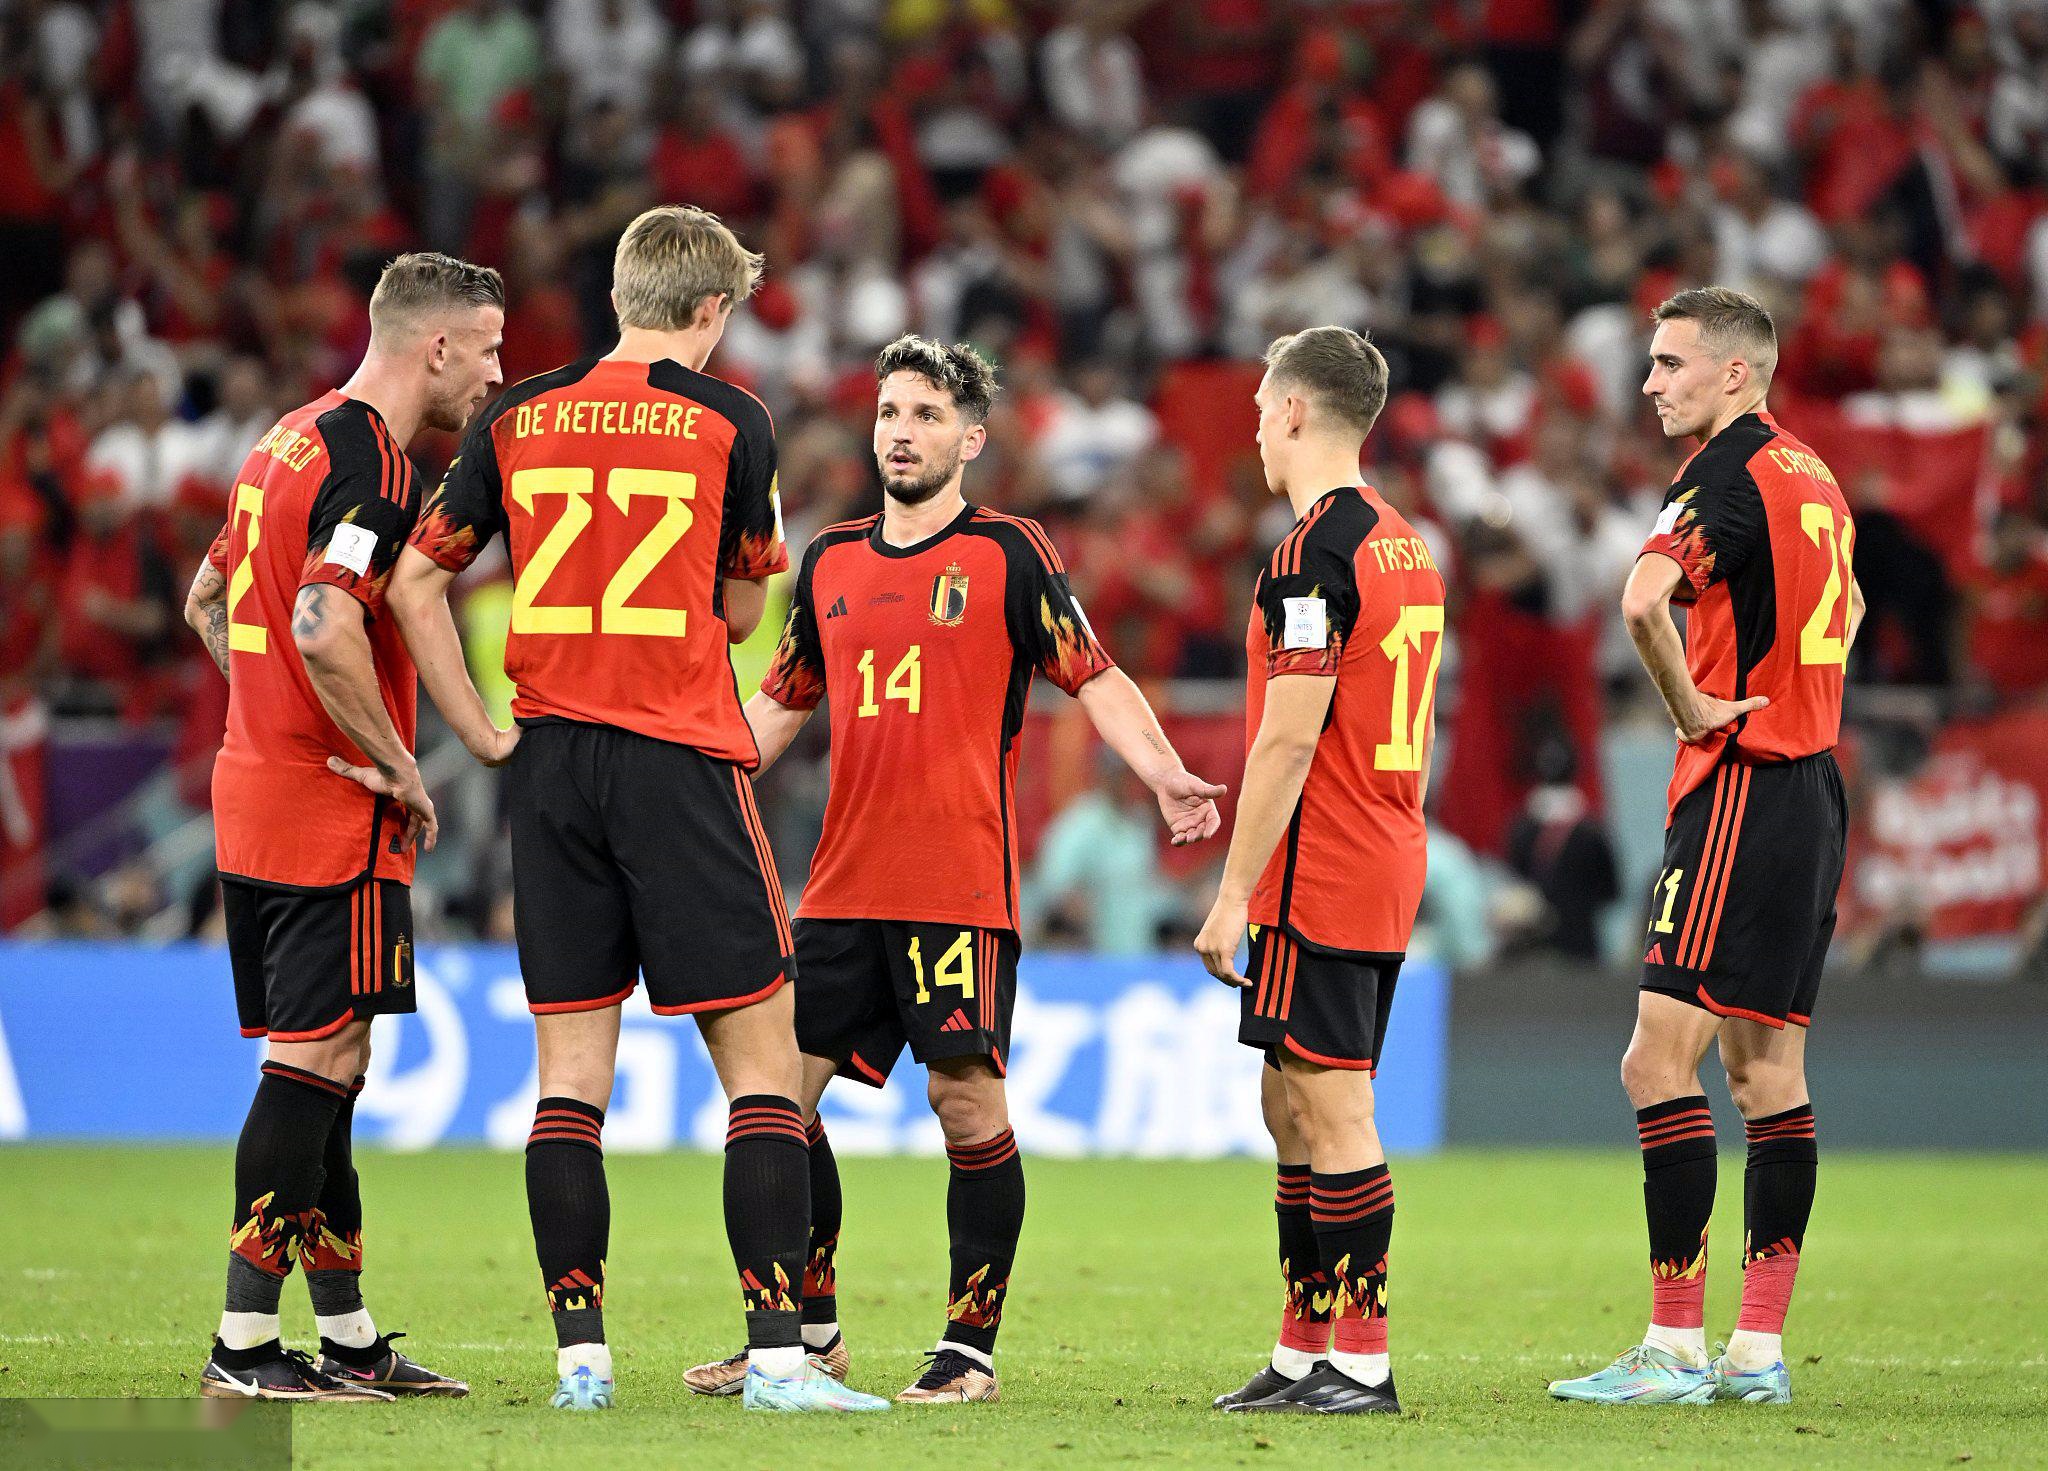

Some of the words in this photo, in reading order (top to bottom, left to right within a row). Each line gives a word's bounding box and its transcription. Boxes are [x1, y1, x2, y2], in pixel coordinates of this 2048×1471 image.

[515, 402, 548, 440] DE
[554, 400, 703, 441] KETELAERE
[227, 482, 268, 655] 2
[510, 466, 698, 638] 22
[856, 644, 921, 718] 14
[1373, 604, 1446, 772] 17
[1646, 867, 1684, 934] 1
[907, 931, 975, 1005] 14
